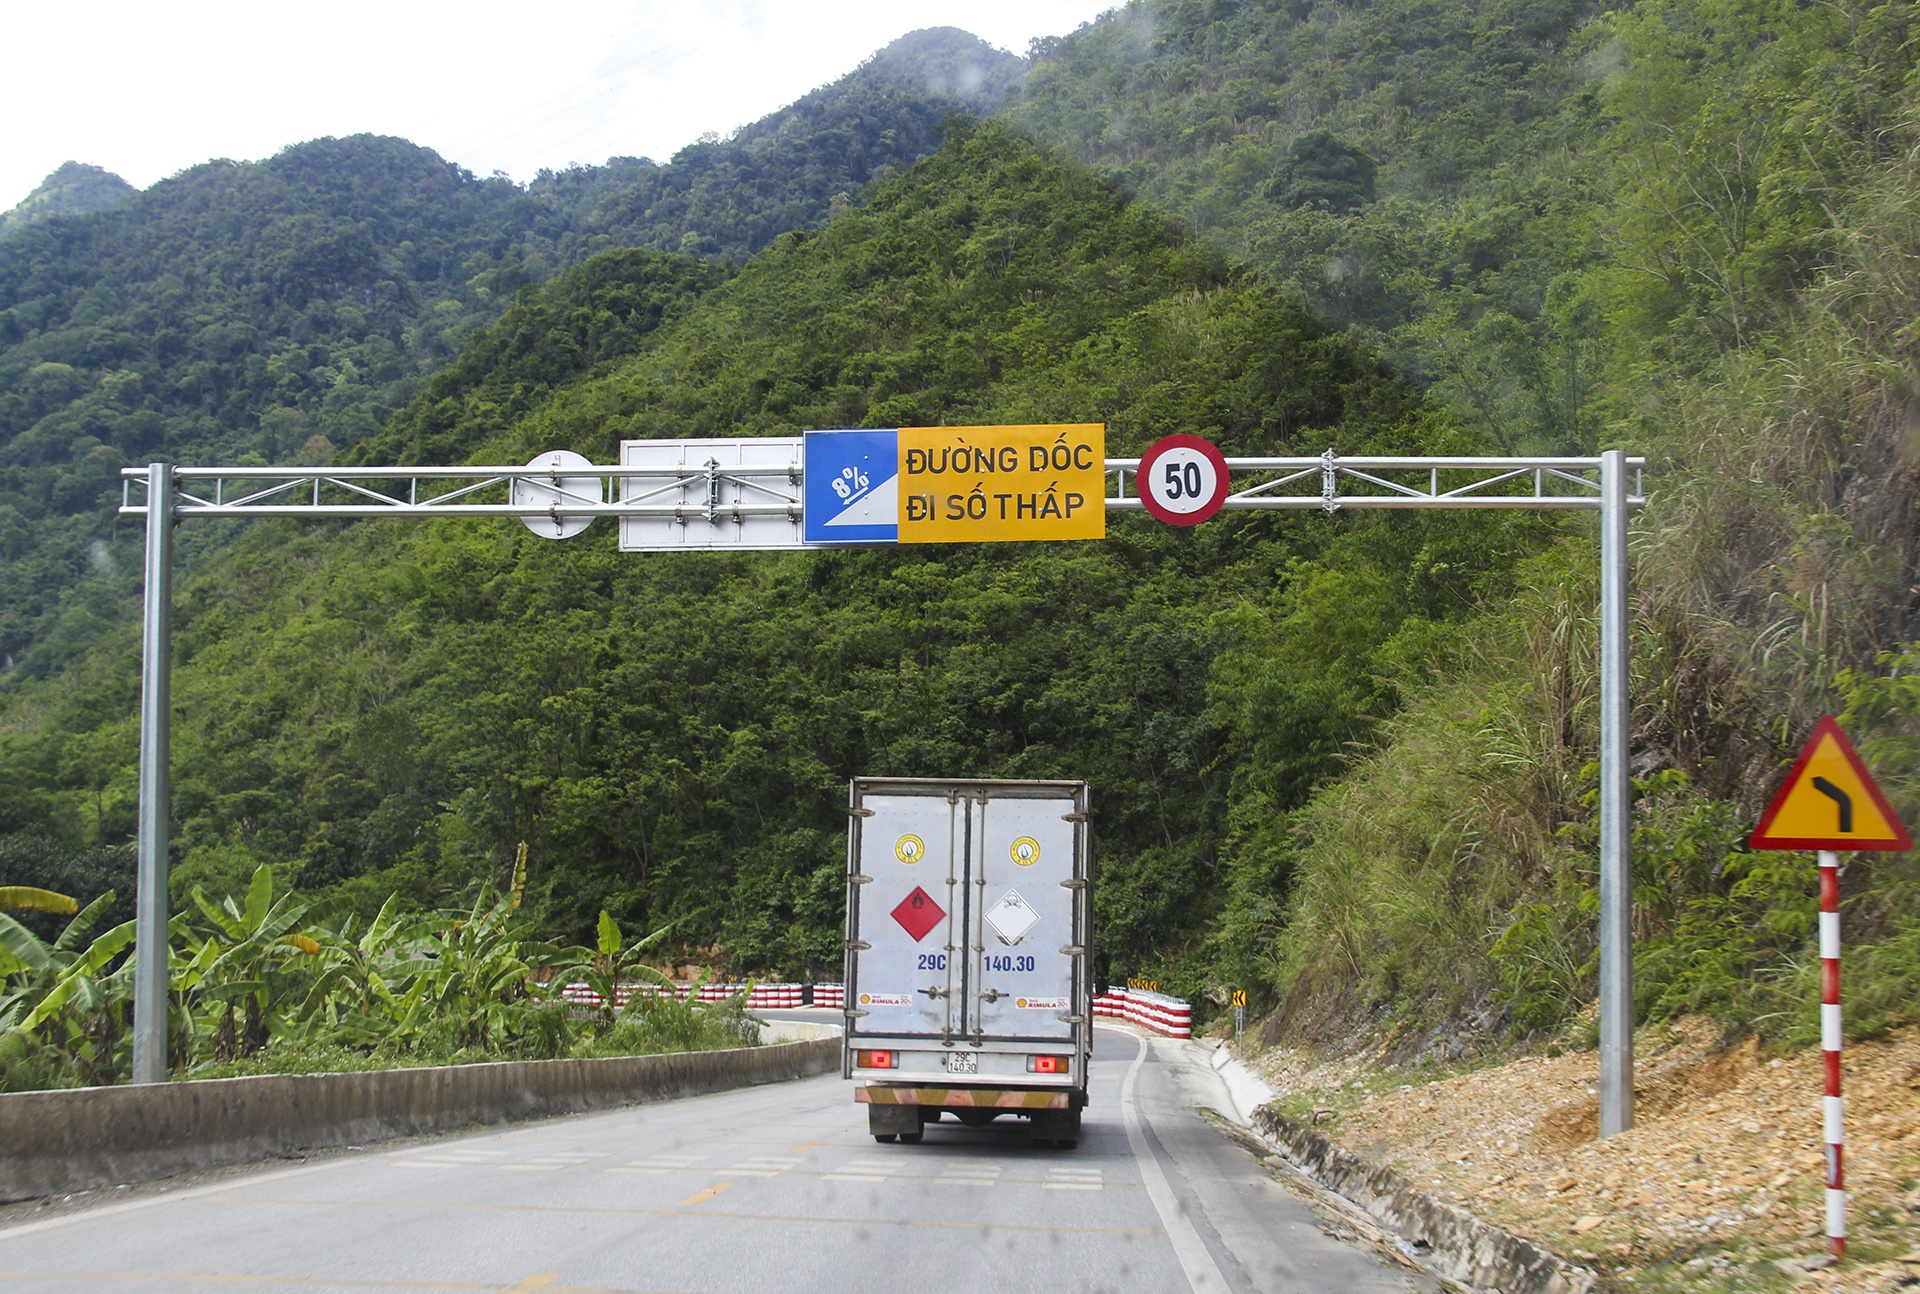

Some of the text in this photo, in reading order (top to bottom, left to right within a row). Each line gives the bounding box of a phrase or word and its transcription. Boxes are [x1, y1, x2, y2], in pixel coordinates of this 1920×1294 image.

[906, 431, 1093, 475] ĐƯỜNG DỐC
[832, 466, 870, 498] 8%
[1165, 462, 1202, 500] 50
[906, 480, 1085, 521] ĐI SỐ THẤP
[918, 954, 1035, 972] 29C 140.30
[955, 1052, 971, 1062] 29C
